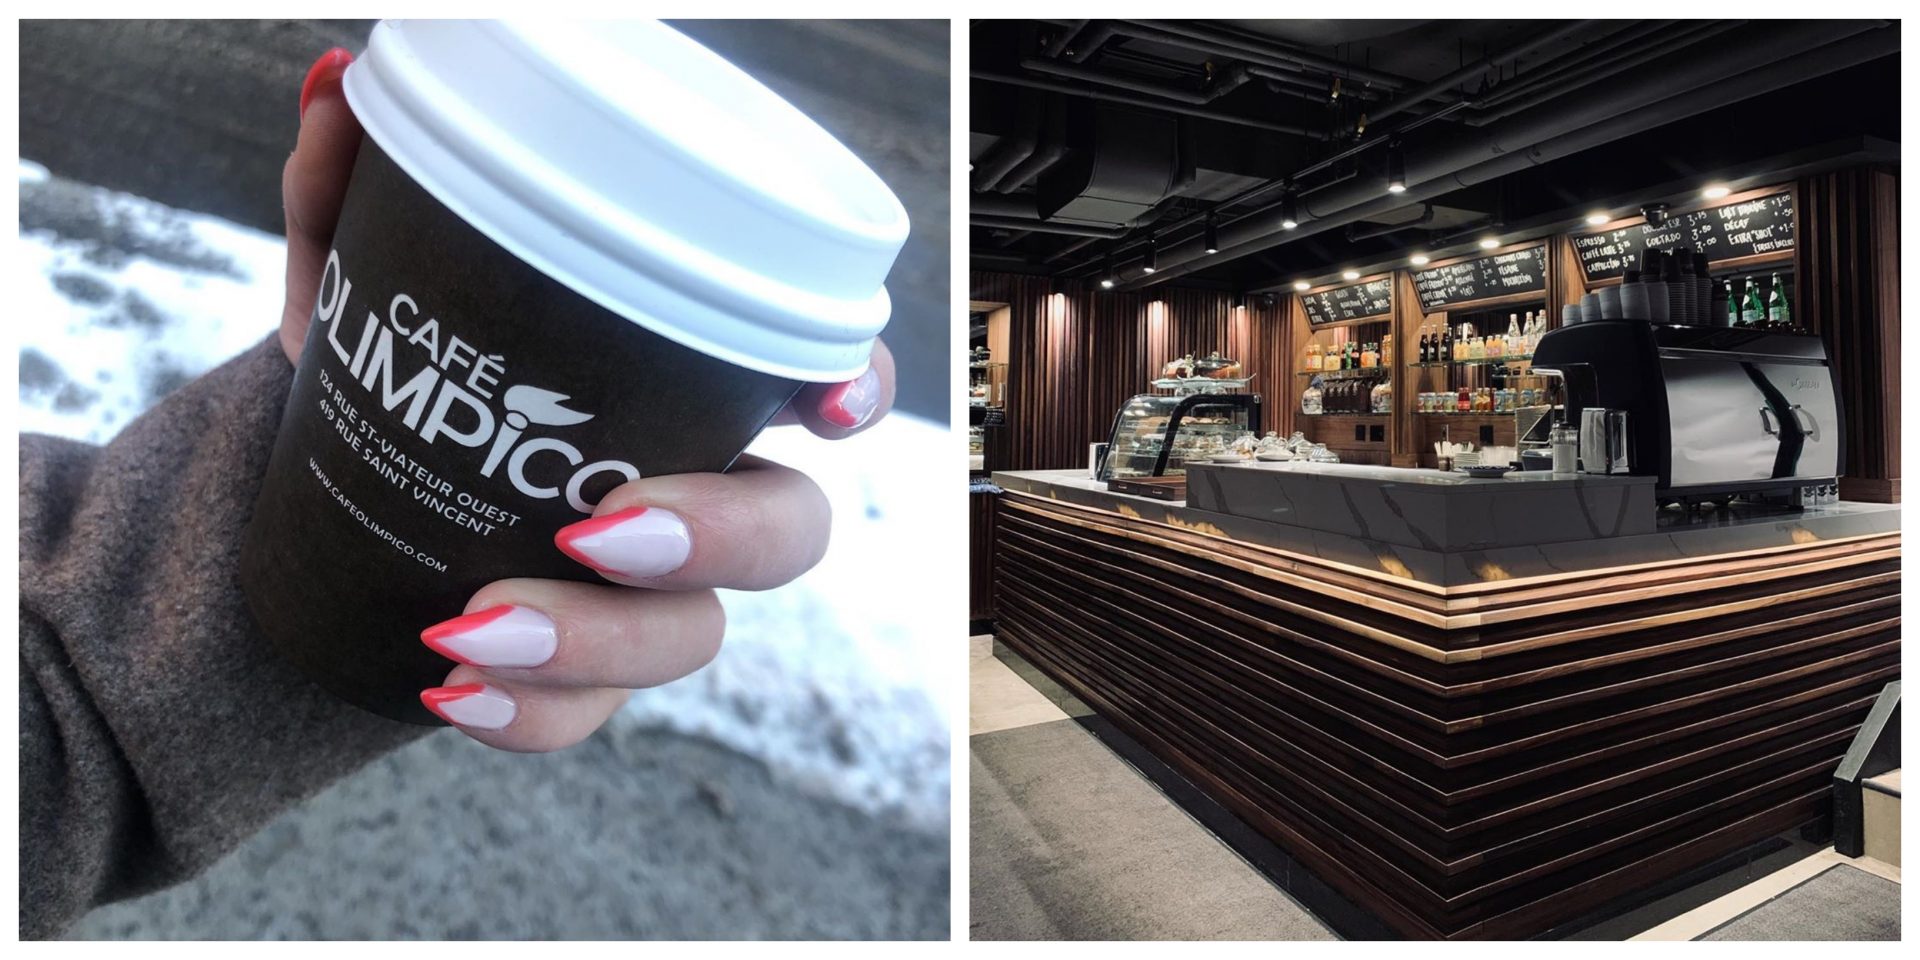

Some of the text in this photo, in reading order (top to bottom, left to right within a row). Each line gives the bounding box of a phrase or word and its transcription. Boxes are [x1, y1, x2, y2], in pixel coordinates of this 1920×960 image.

[1576, 236, 1606, 248] ESPRESSO
[1645, 232, 1681, 248] CORTADO
[1727, 232, 1753, 246] EXTRA
[389, 293, 506, 400] CAFÉ
[319, 368, 521, 527] 124 RUE ST-VIATEUR OUEST
[319, 399, 496, 536] 419 RUE SAINT VINCENT
